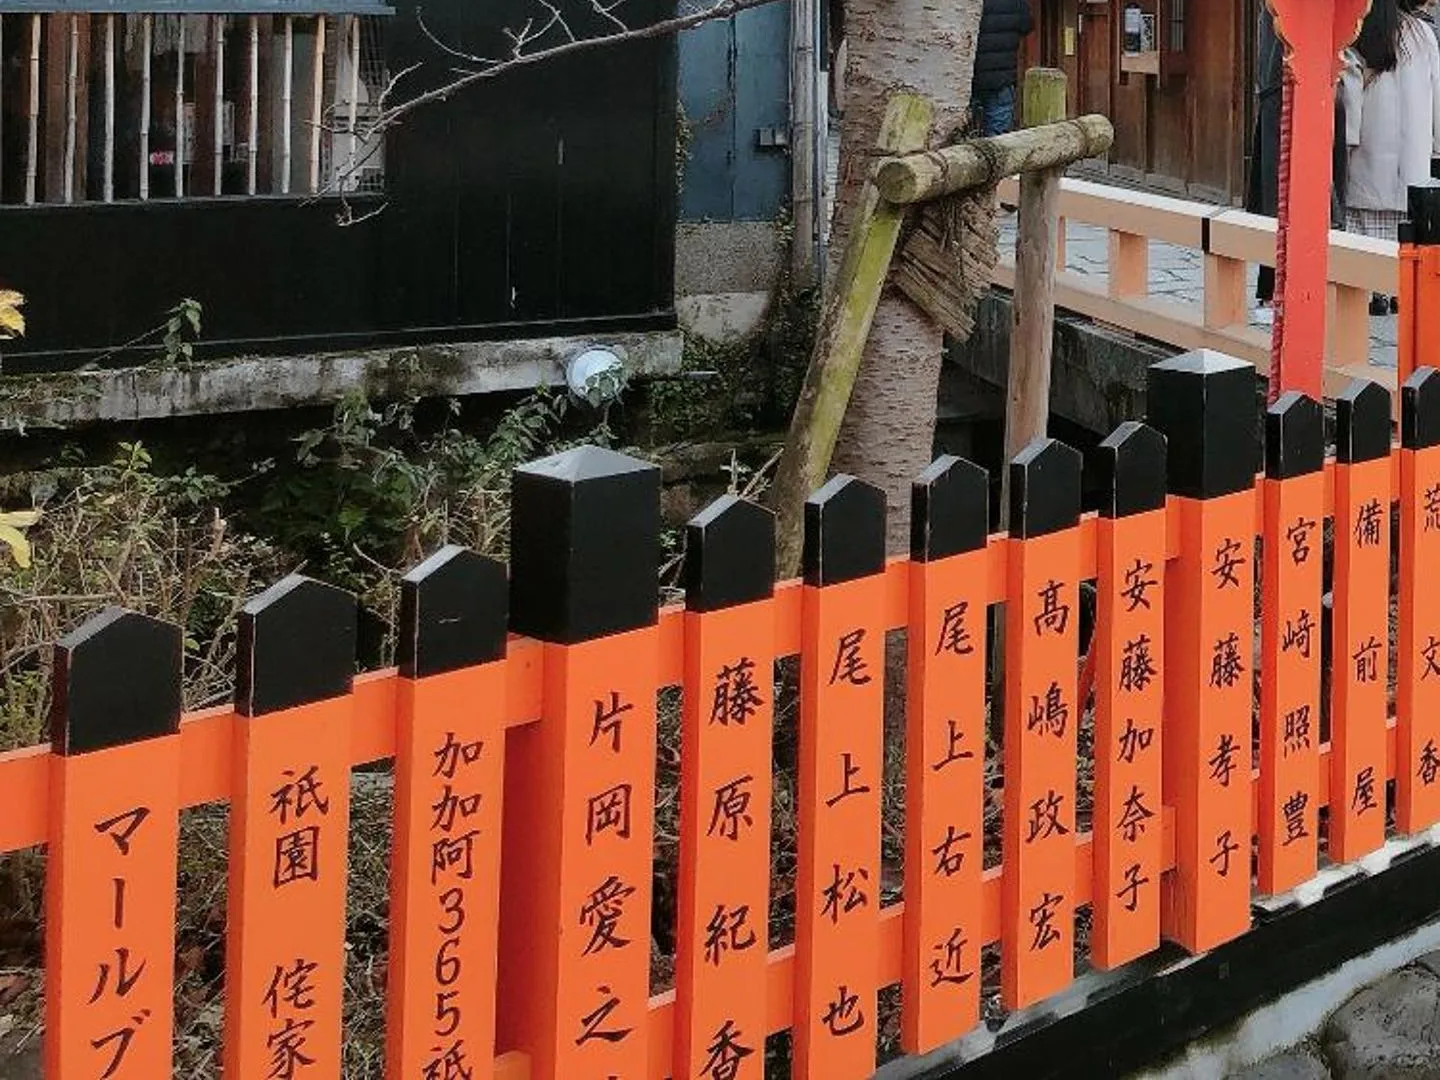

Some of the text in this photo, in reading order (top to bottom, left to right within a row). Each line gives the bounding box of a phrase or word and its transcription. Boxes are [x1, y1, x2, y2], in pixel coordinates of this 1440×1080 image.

[821, 628, 872, 1037] 尾上松也
[929, 601, 974, 988] 尾上右近
[1116, 559, 1159, 912] 安藤加奈子
[1209, 538, 1246, 877] 安藤孝子
[1351, 497, 1384, 817] 備前屋
[89, 806, 151, 1080] マールブ
[262, 765, 329, 1080] 祇園 侘家
[576, 691, 636, 1080] 片岡愛之
[700, 657, 765, 1080] 藤原紀香
